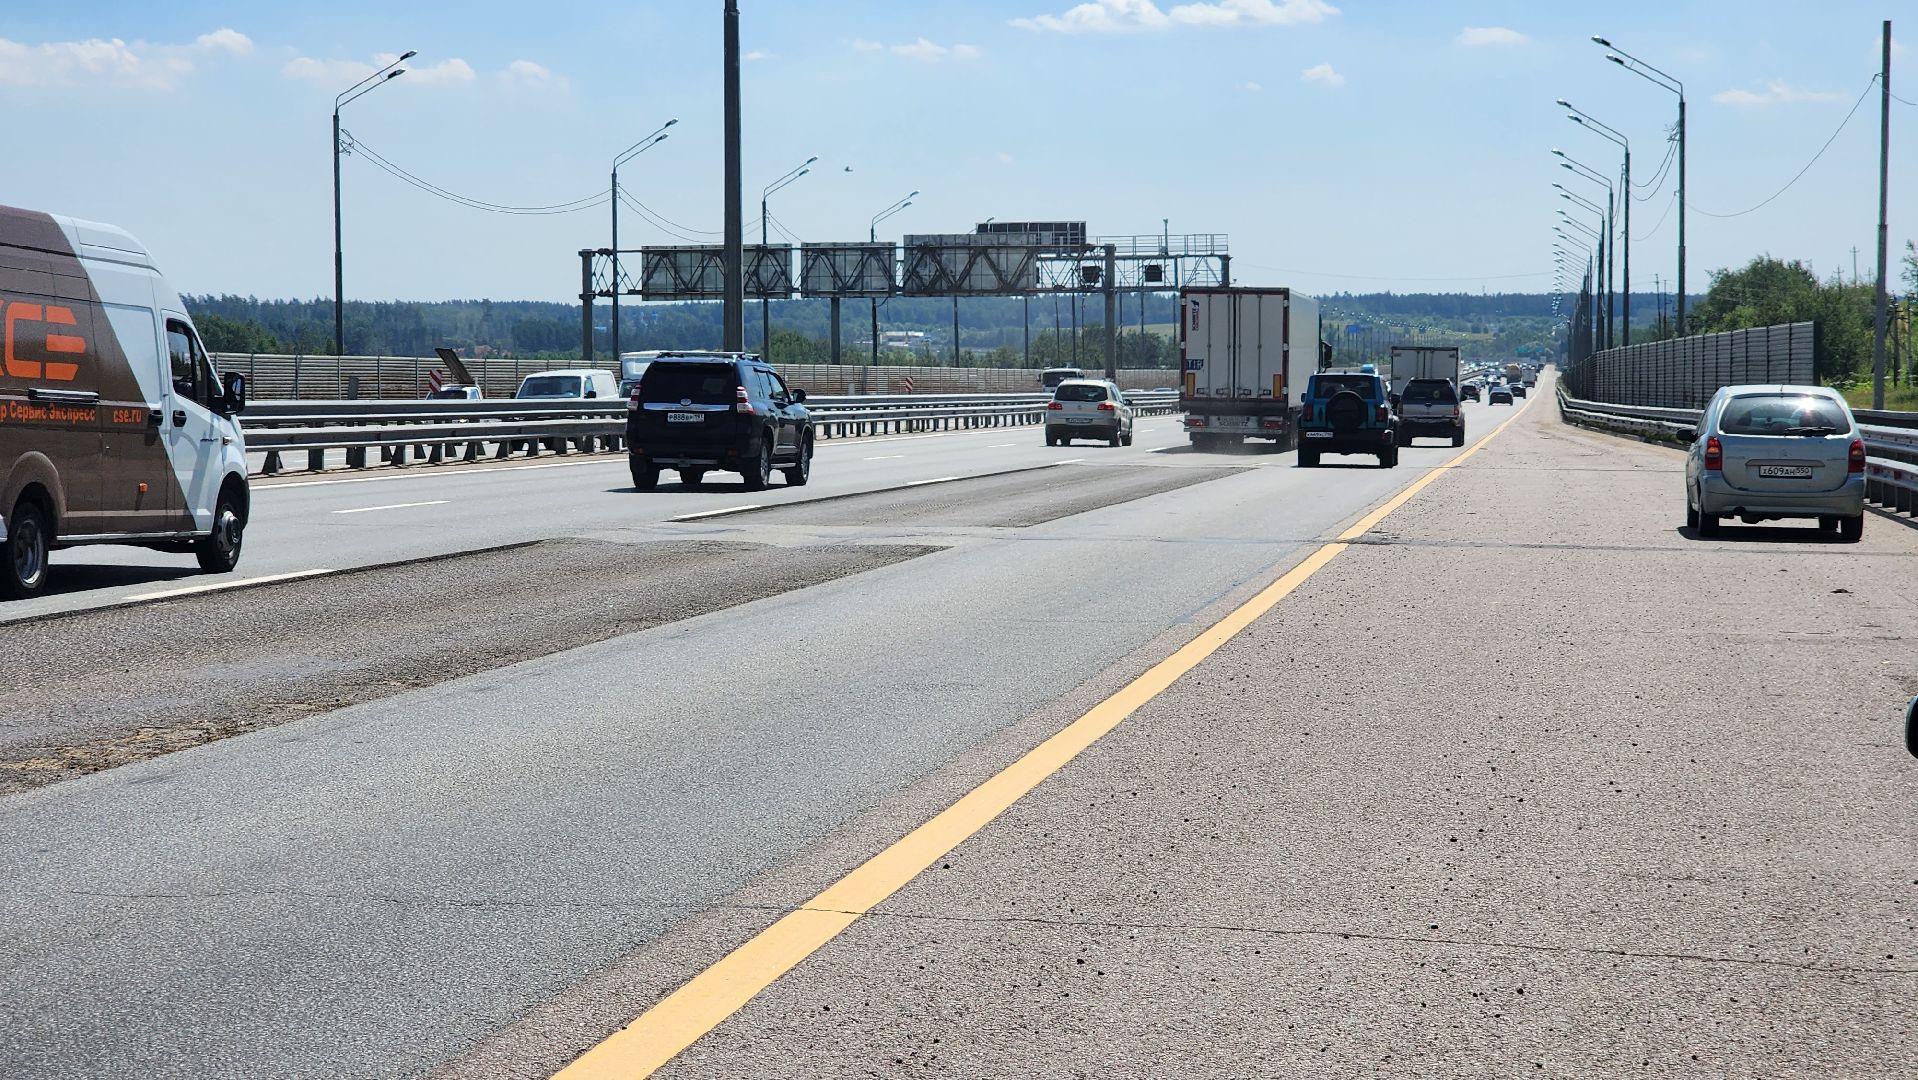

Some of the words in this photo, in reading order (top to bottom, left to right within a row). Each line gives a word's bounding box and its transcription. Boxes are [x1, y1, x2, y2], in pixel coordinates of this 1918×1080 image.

[1188, 359, 1203, 370] TIR
[10, 400, 47, 423] Сервис
[49, 402, 96, 424] Экспресс
[113, 408, 142, 423] cse.ru
